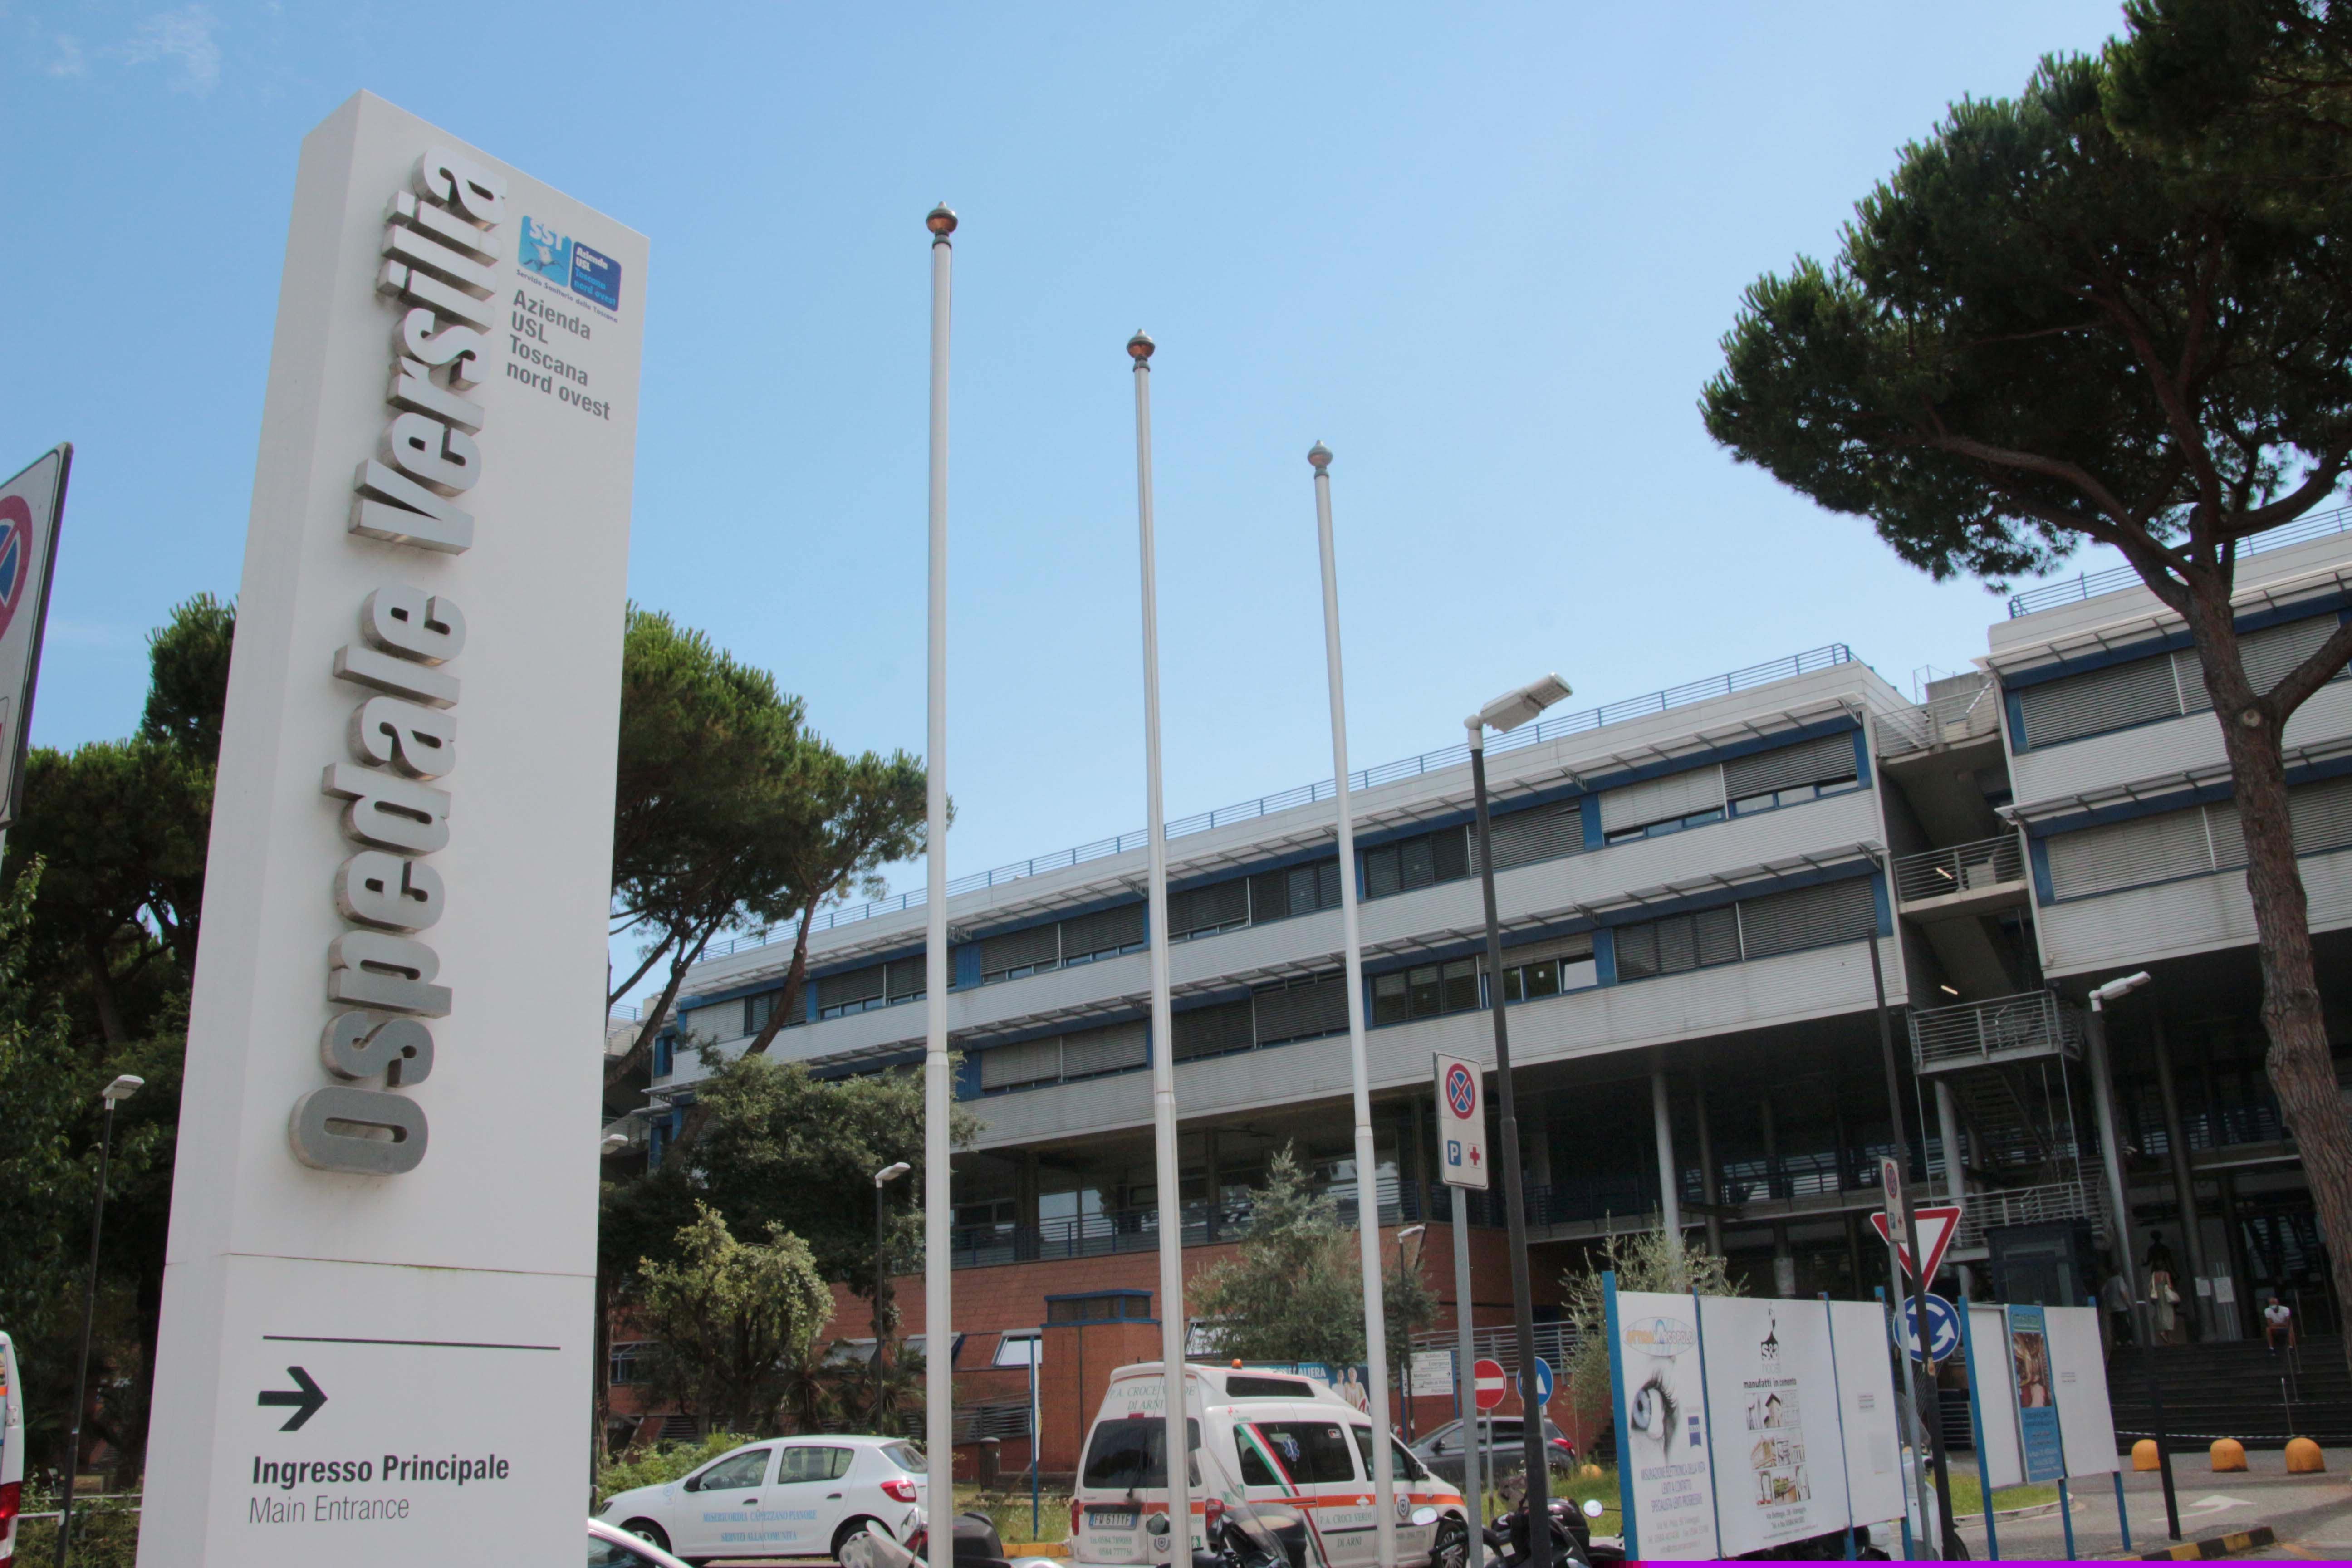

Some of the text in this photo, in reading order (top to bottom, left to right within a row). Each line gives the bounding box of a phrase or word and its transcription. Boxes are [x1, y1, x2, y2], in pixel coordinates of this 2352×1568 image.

[529, 218, 567, 251] SST
[576, 247, 608, 270] Azienda
[576, 257, 591, 272] USL
[575, 267, 607, 289] Toscana
[516, 269, 618, 323] Servizio Sanitario della Toscana
[574, 279, 616, 306] nord ovest
[513, 289, 591, 340] Azienda
[511, 311, 549, 344] USL
[510, 334, 588, 387] Toscana
[506, 362, 611, 421] nord ovest
[289, 146, 507, 1176] Ospedale Versilia
[1450, 1143, 1459, 1162] P
[1127, 1386, 1157, 1396] CROCE
[1743, 1378, 1771, 1389] manufatti
[1773, 1377, 1779, 1387] in
[1127, 1400, 1164, 1411] DI ARNI
[252, 1454, 510, 1490] Ingresso Principale
[249, 1495, 409, 1524] Main Entrance
[703, 1509, 817, 1522] MISERICORDIA CAPEZZANO PIANORE
[1094, 1514, 1106, 1525] FW
[1333, 1514, 1354, 1524] CROCE
[1355, 1512, 1372, 1522] VERDE
[721, 1532, 745, 1542] SERVIZI
[1337, 1536, 1362, 1548] DI ARNI
